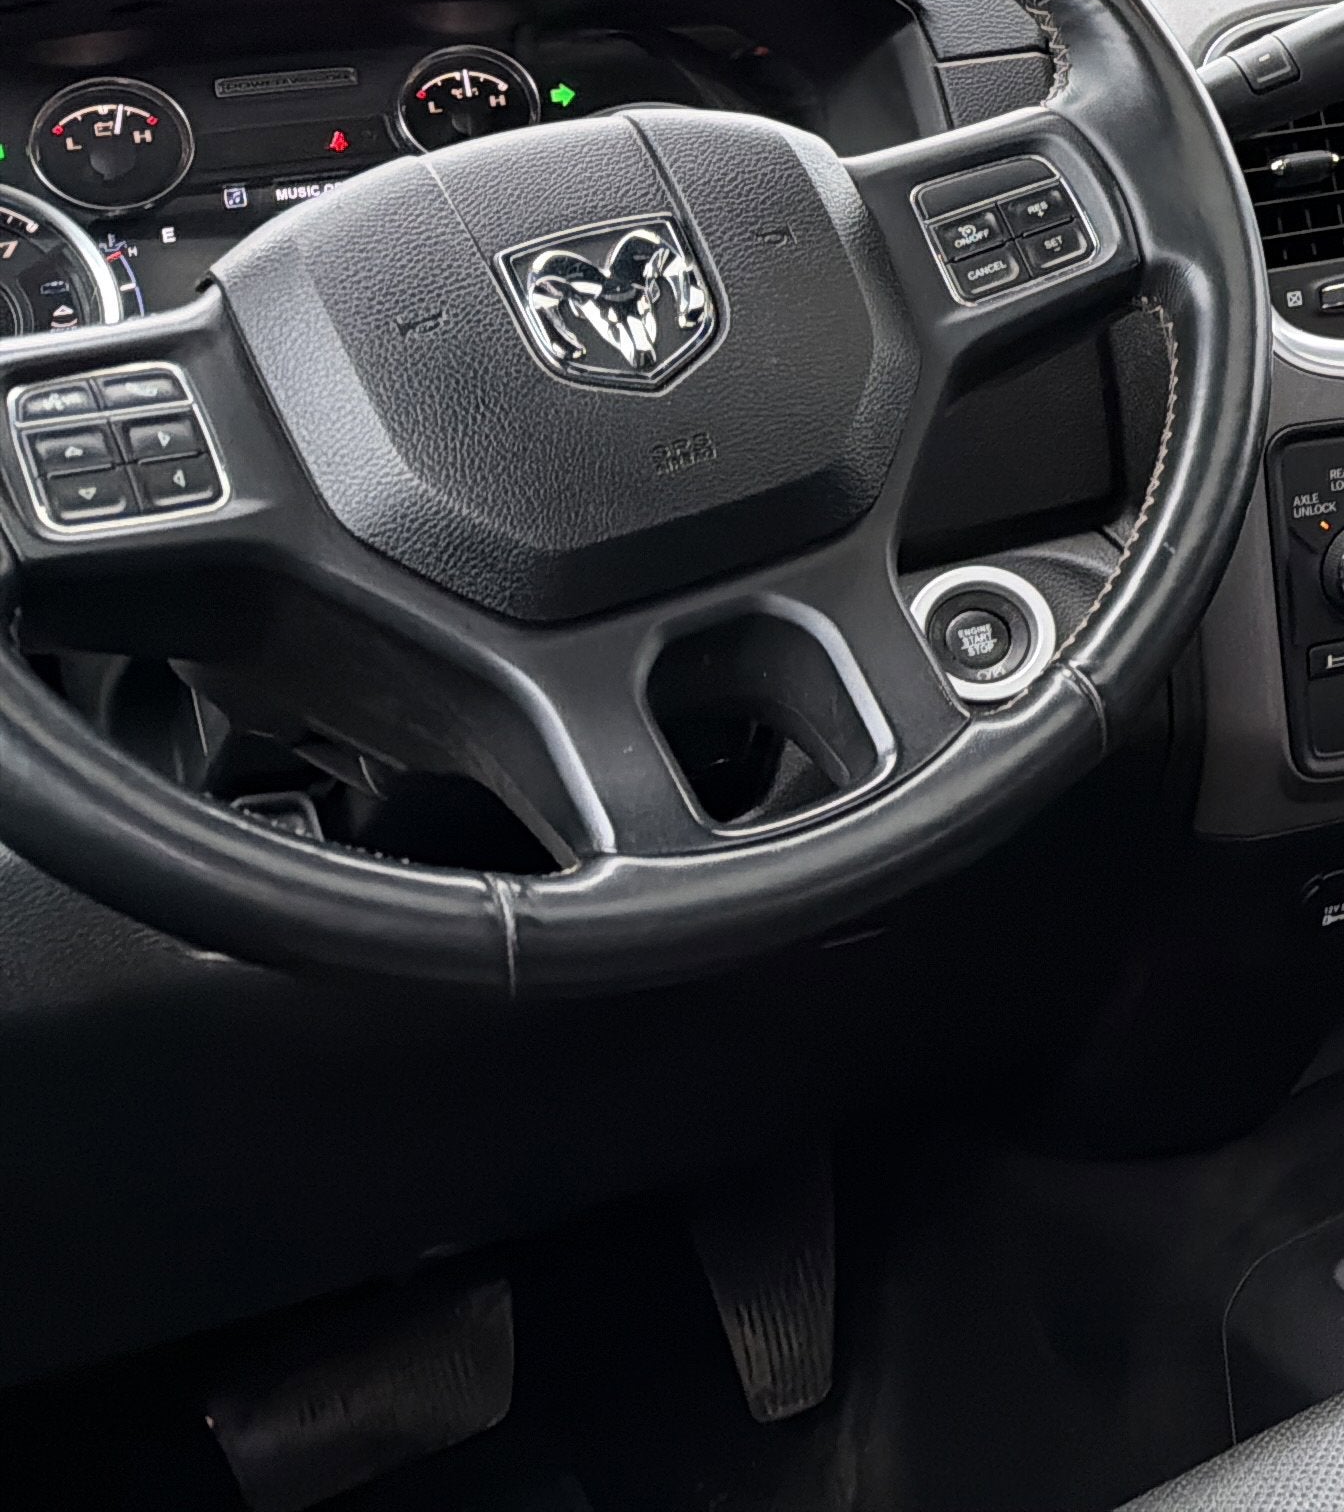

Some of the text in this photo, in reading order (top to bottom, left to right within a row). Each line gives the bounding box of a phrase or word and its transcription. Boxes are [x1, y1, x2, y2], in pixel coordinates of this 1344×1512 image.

[428, 94, 507, 114] L H
[66, 130, 152, 151] L H
[275, 185, 321, 201] MUSIC
[1027, 201, 1048, 215] RES
[161, 226, 176, 243] E
[954, 228, 989, 248] ON/OFF
[1044, 235, 1062, 250] SET
[967, 260, 1007, 281] CANCEL
[1293, 493, 1319, 507] AXLE
[1293, 501, 1337, 518] UNLOCK
